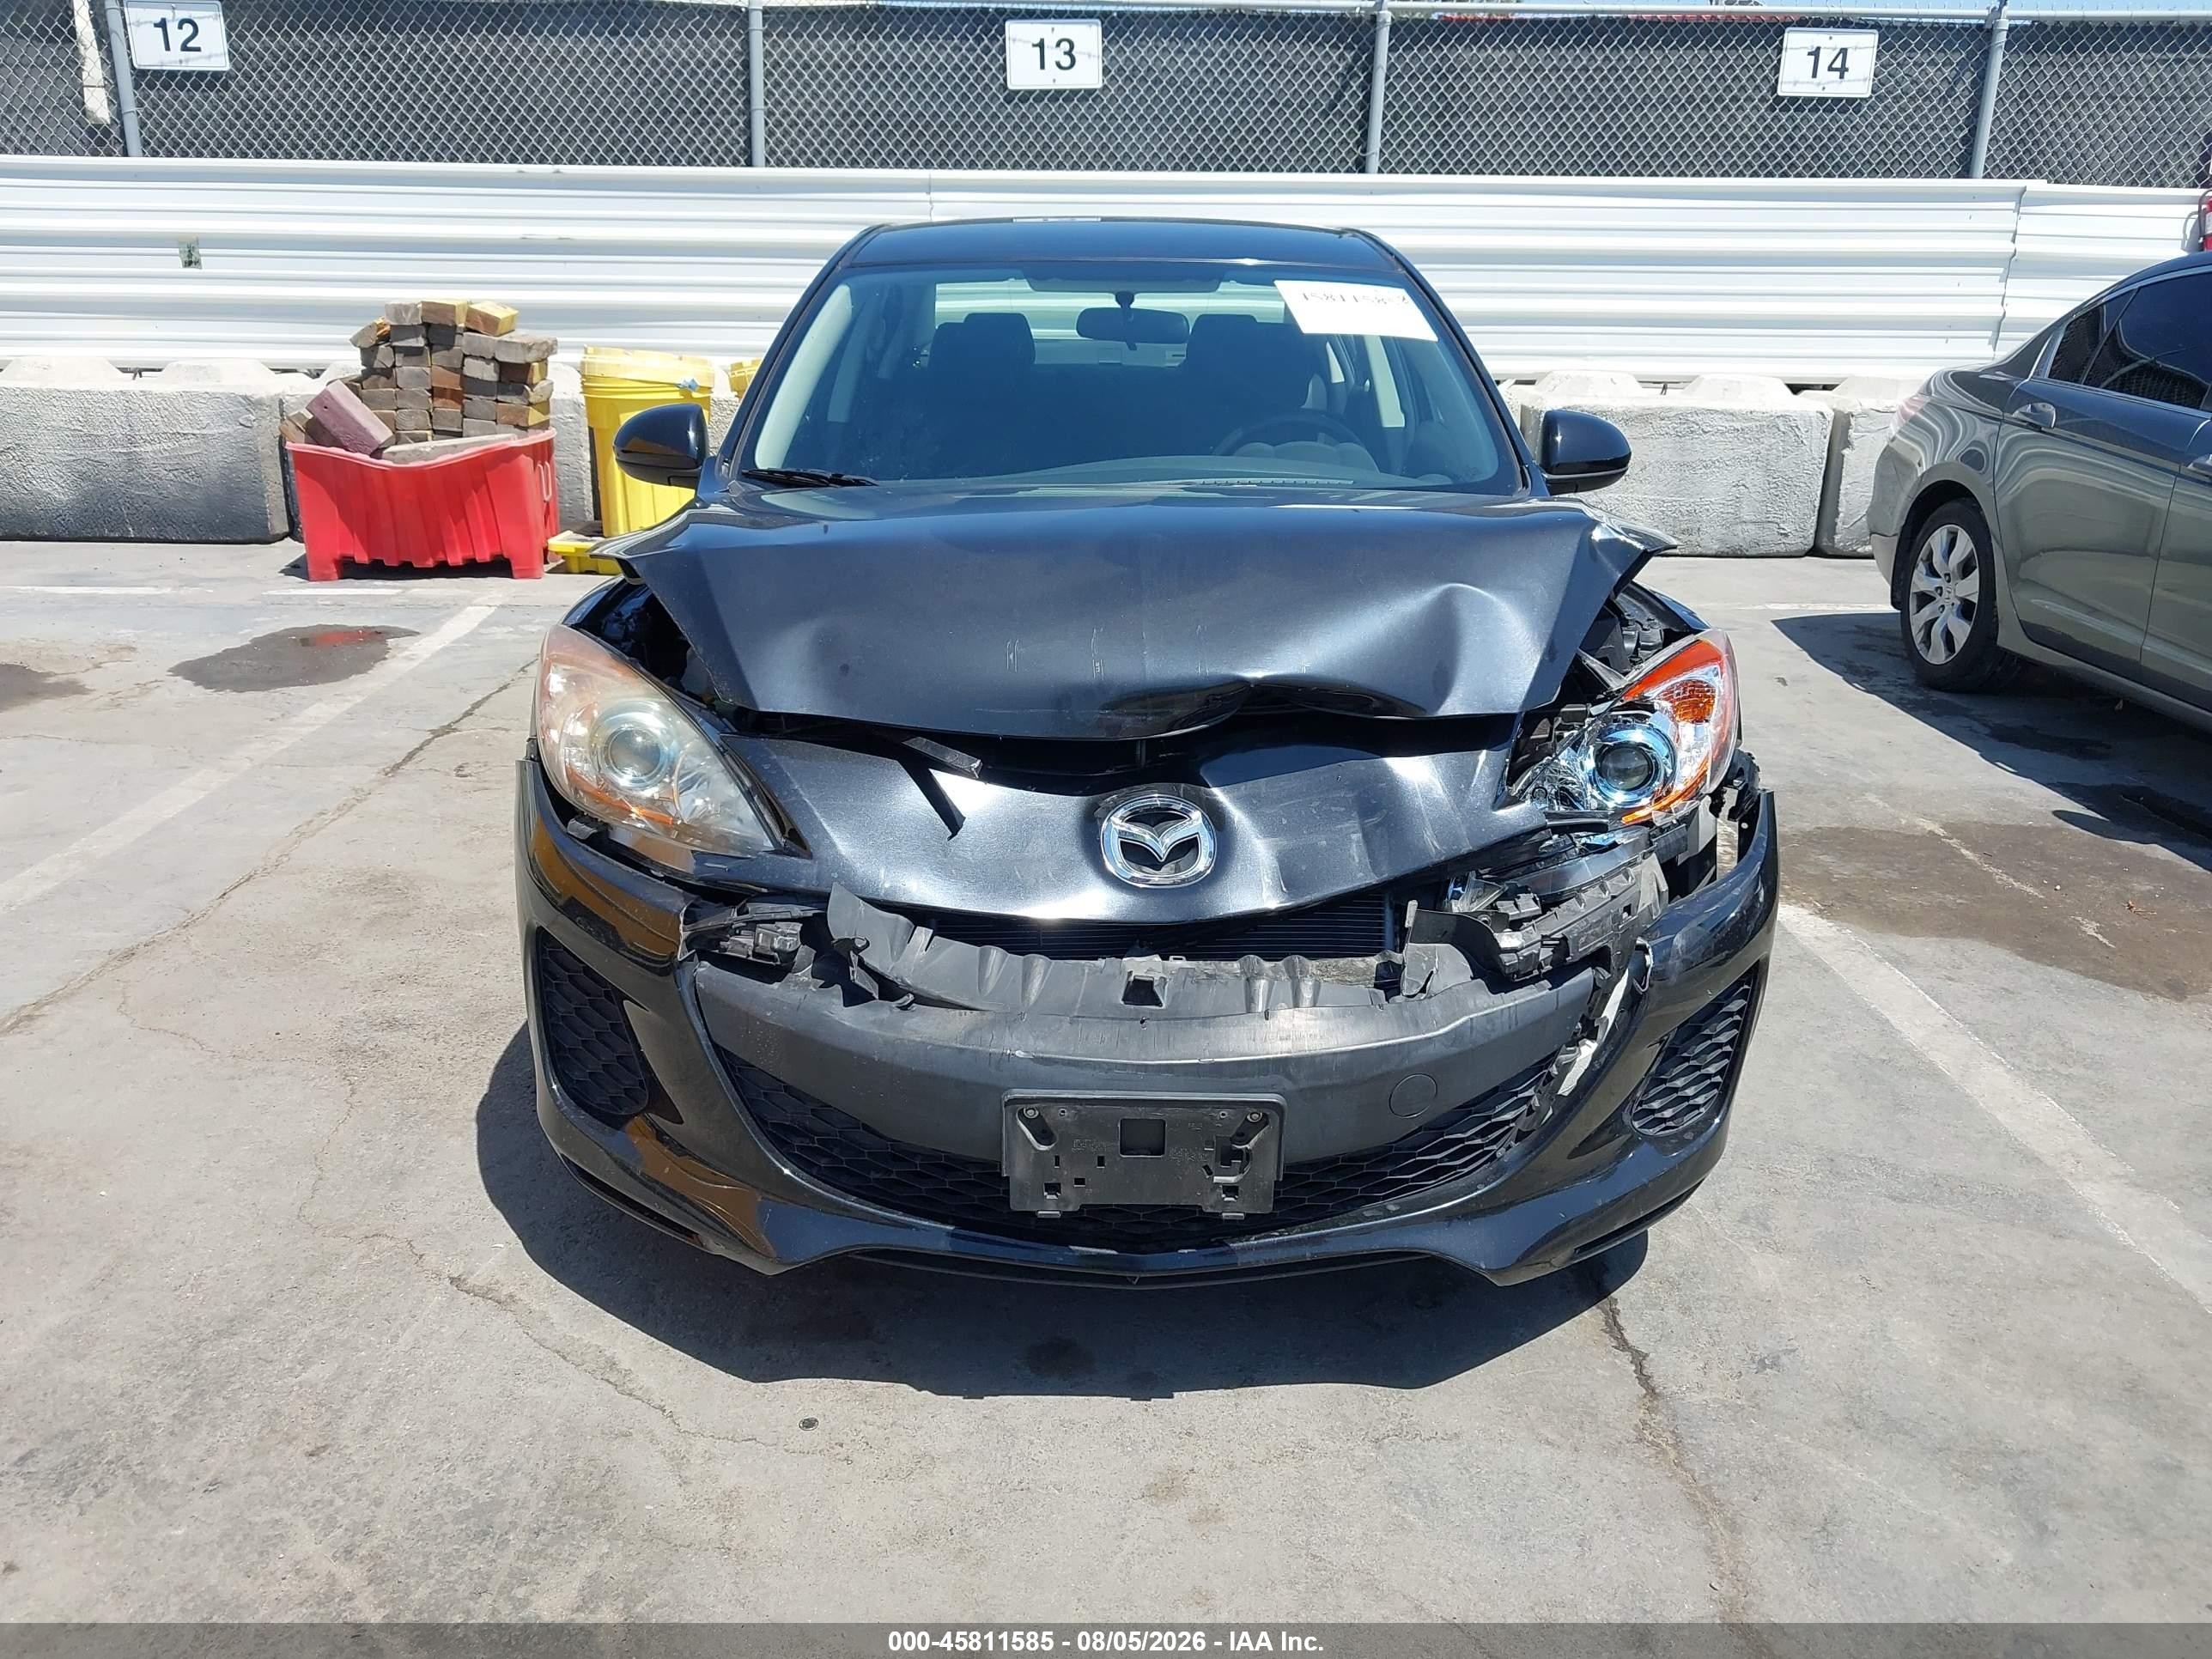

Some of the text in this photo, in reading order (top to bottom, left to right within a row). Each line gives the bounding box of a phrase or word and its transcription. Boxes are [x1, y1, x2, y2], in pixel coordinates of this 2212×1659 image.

[154, 18, 202, 52] 12
[1032, 38, 1076, 70] 13
[1807, 46, 1849, 80] 14
